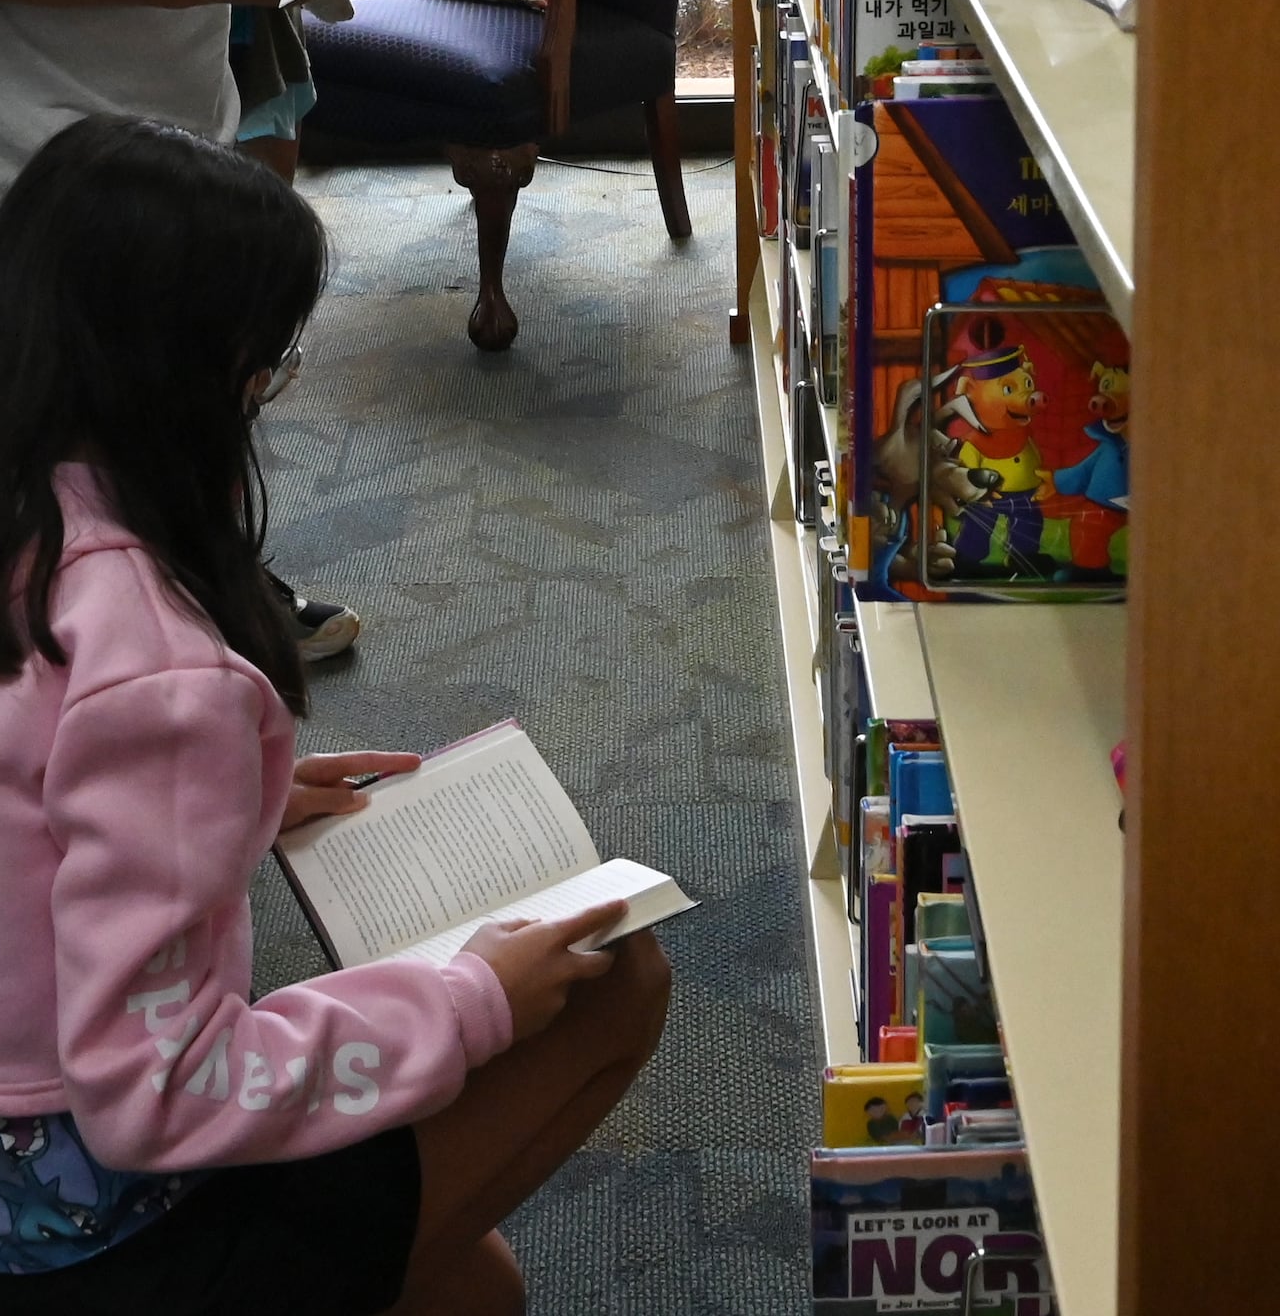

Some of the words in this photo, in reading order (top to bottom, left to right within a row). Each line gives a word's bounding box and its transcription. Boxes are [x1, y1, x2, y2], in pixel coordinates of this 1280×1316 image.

[897, 19, 957, 41] 과일과
[853, 1218, 906, 1234] LET'S
[911, 1214, 960, 1231] LOOK
[966, 1213, 990, 1228] AT
